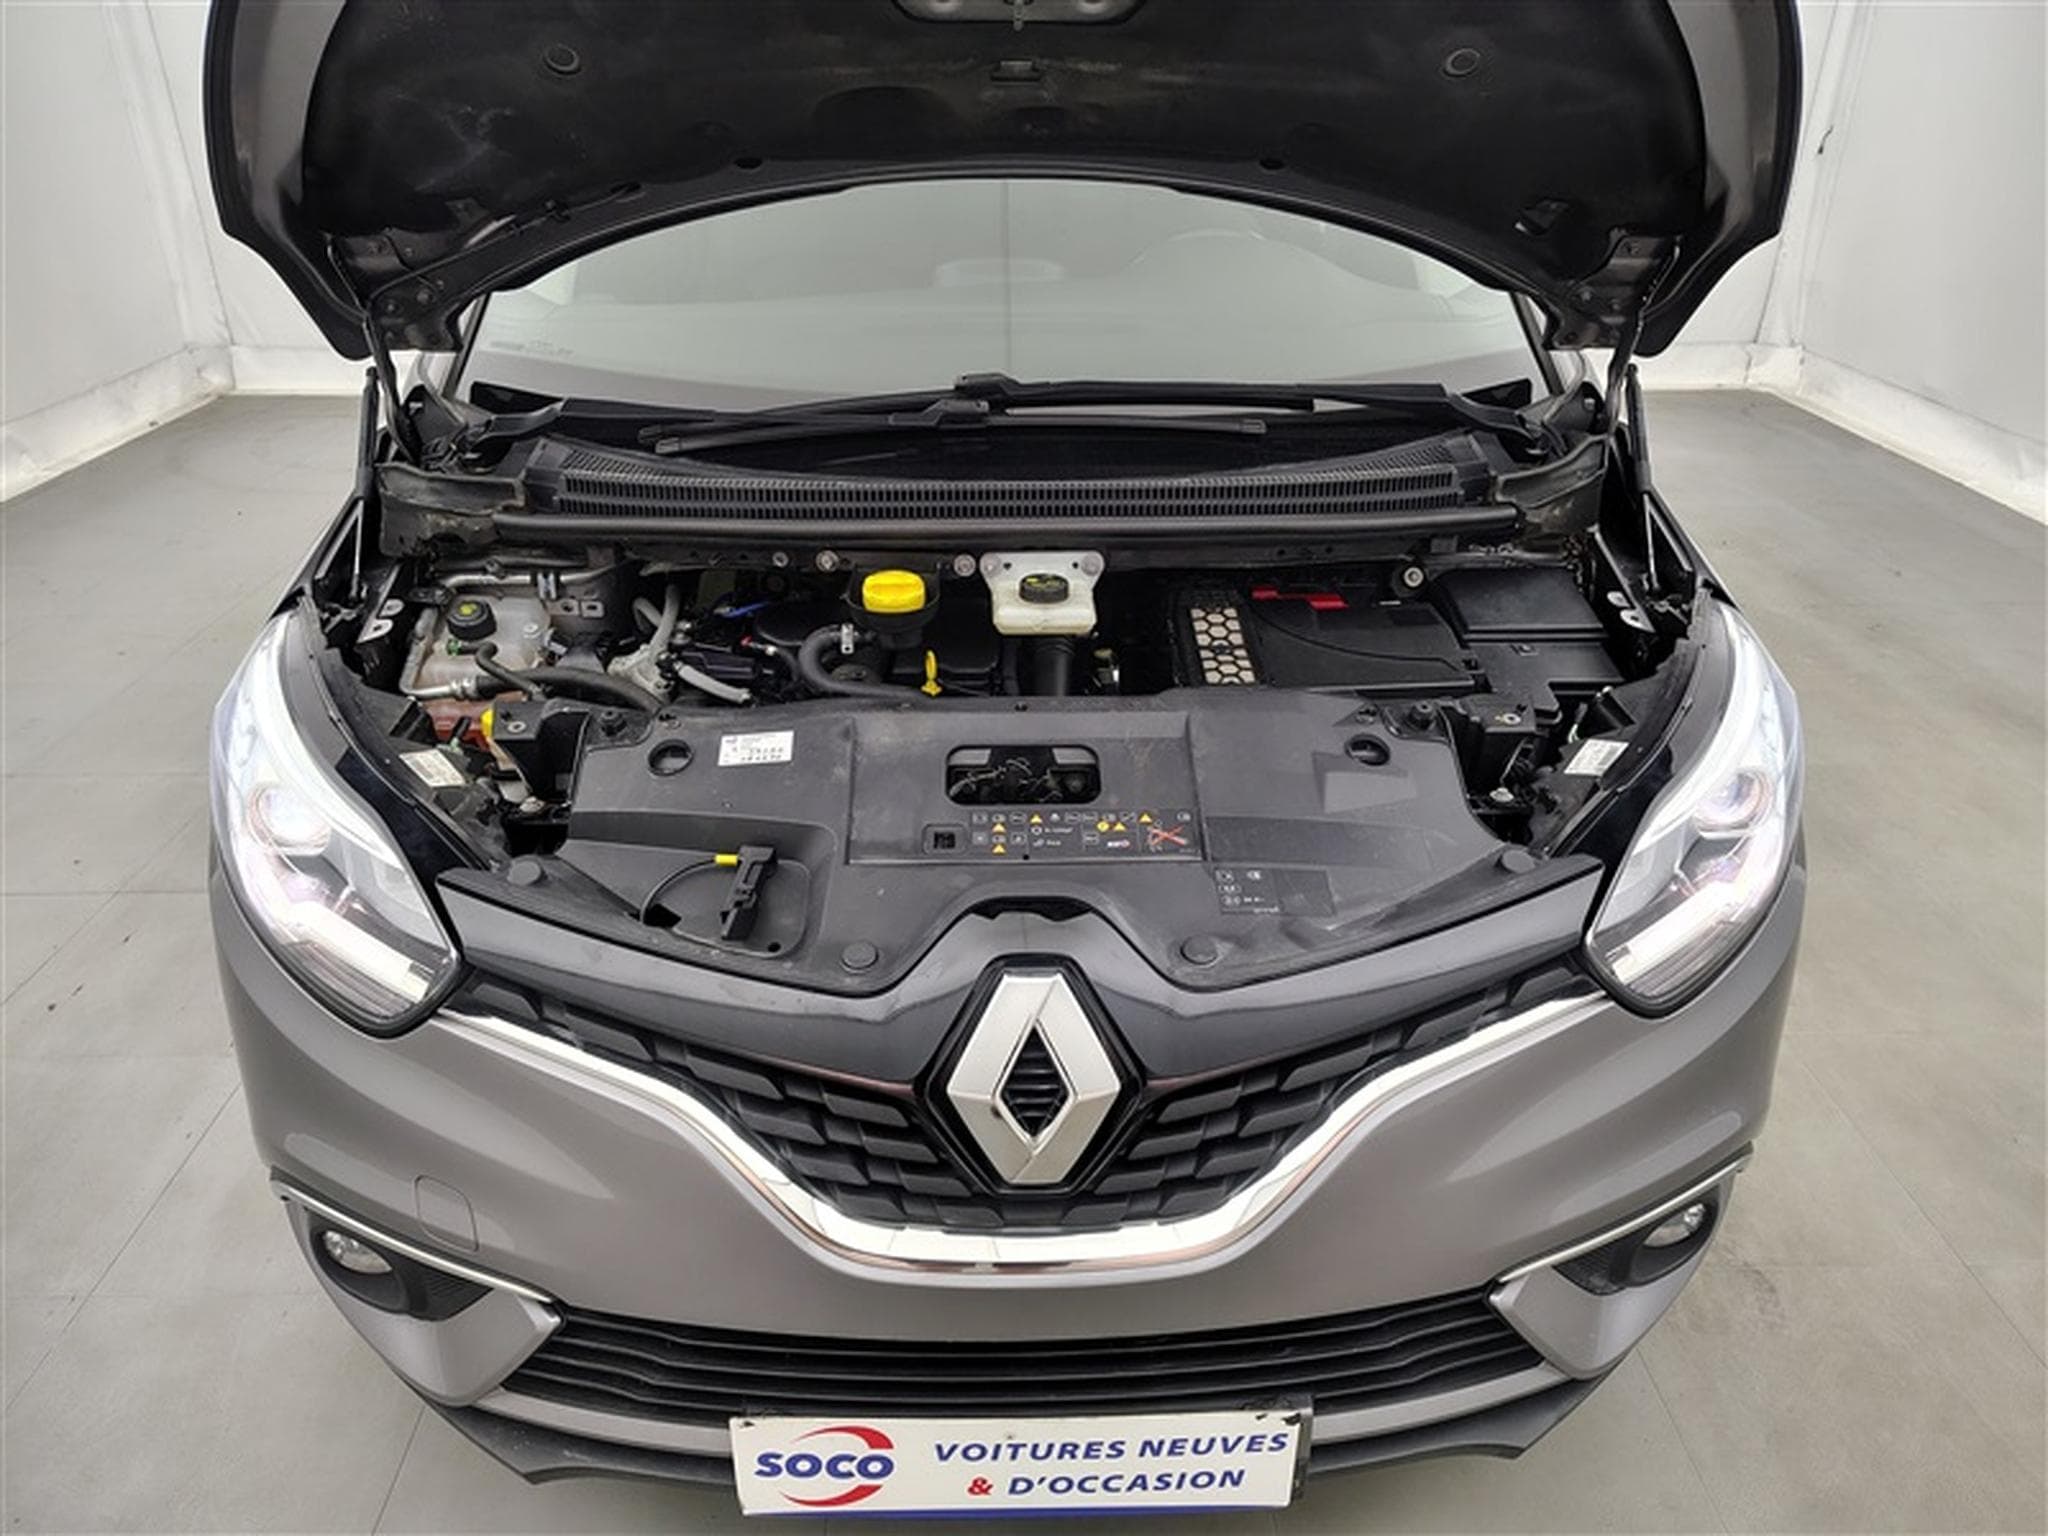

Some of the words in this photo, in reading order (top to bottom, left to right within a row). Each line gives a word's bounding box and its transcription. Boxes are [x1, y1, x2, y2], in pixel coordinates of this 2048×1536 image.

[935, 1440, 1127, 1463] VOITURES
[1139, 1433, 1289, 1457] NEUVES
[755, 1452, 895, 1480] SOCO
[967, 1477, 992, 1496] &
[1007, 1470, 1246, 1496] D'OCCASION
